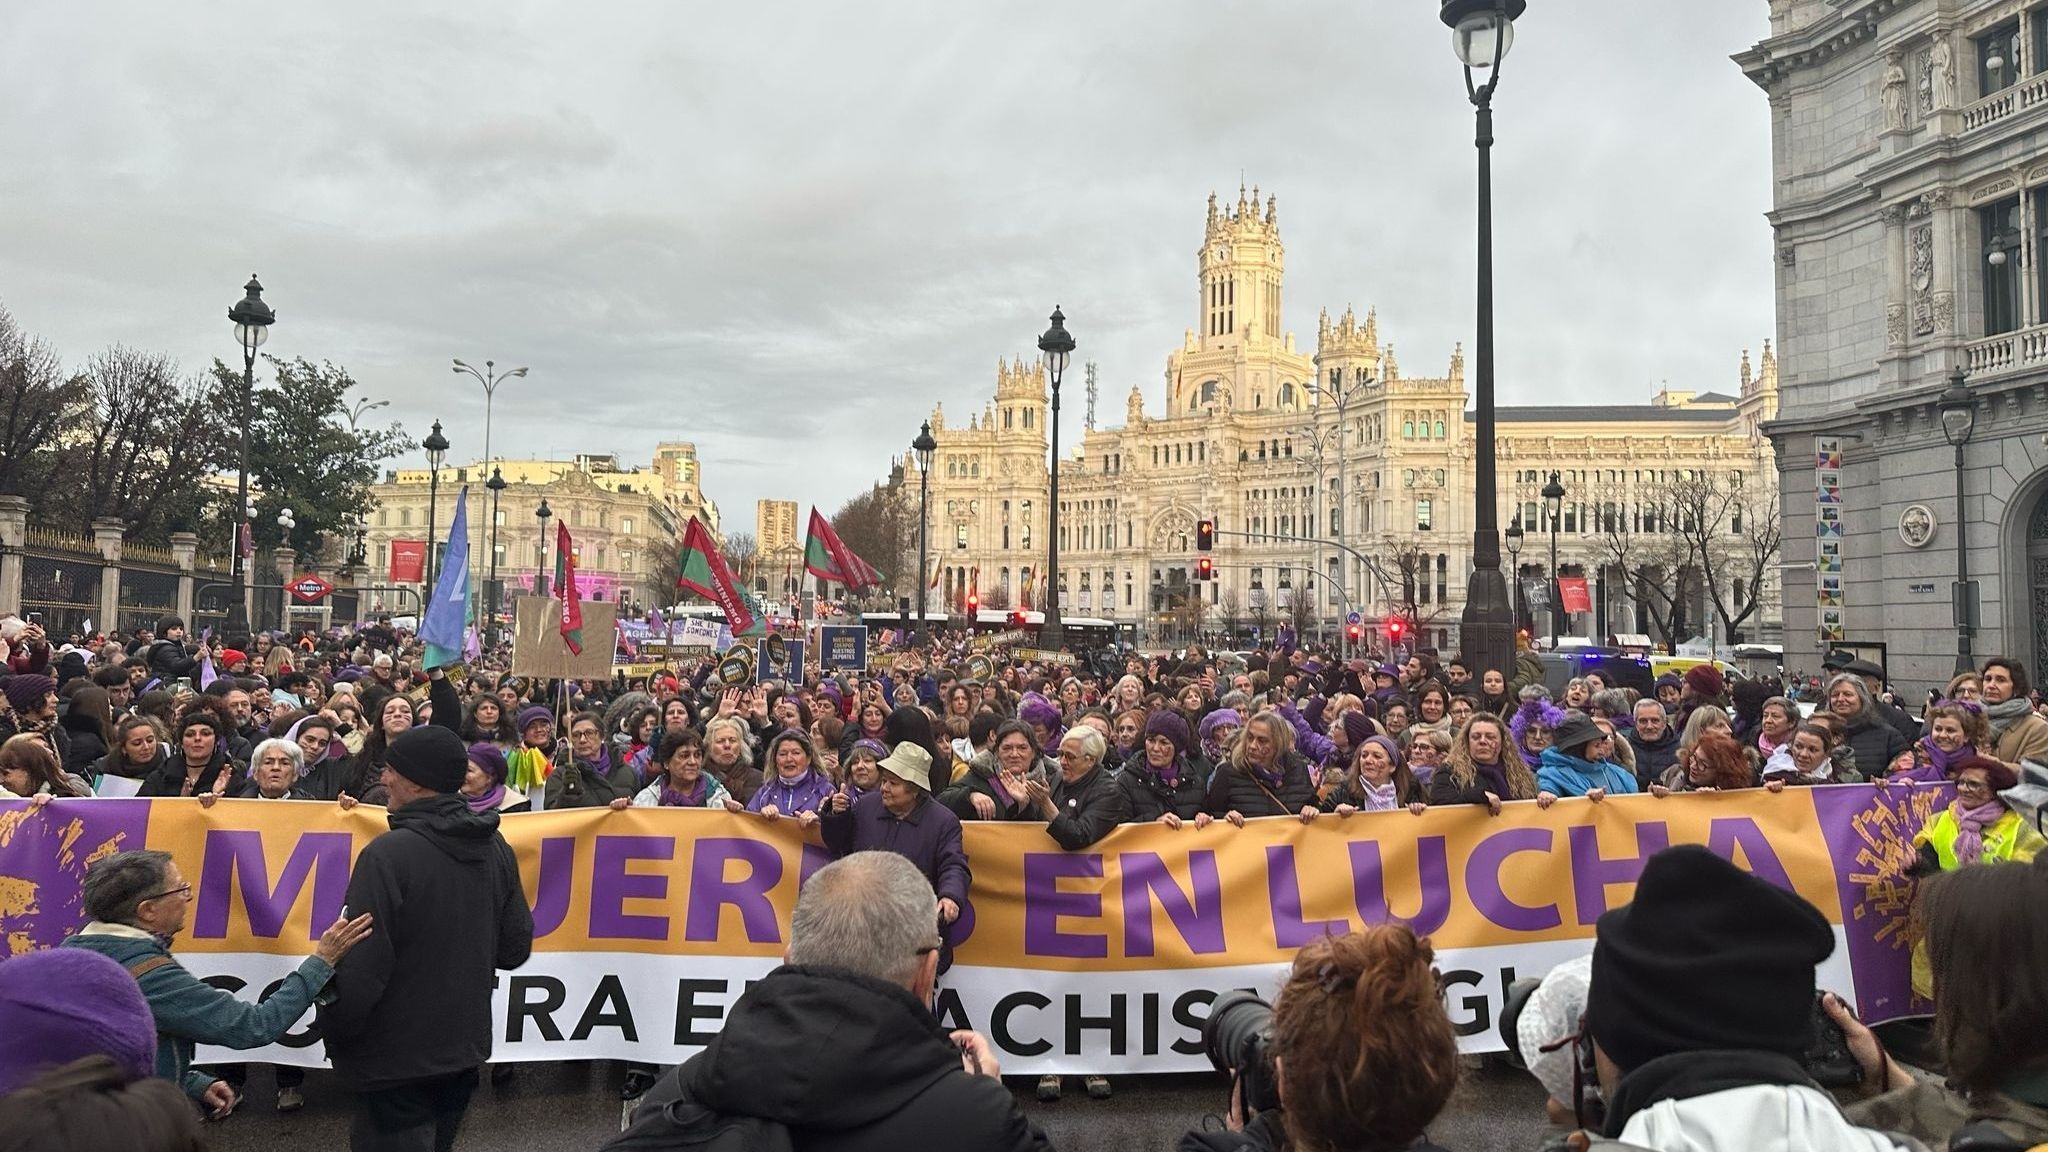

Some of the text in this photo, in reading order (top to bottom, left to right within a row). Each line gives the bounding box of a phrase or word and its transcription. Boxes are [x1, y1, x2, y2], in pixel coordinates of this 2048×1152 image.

[299, 584, 321, 592] Metro
[691, 620, 714, 629] SHE IS
[625, 630, 667, 639] AGENA
[193, 816, 1799, 959] MJER EN LUCHA
[934, 985, 1258, 1057] ACHIS
